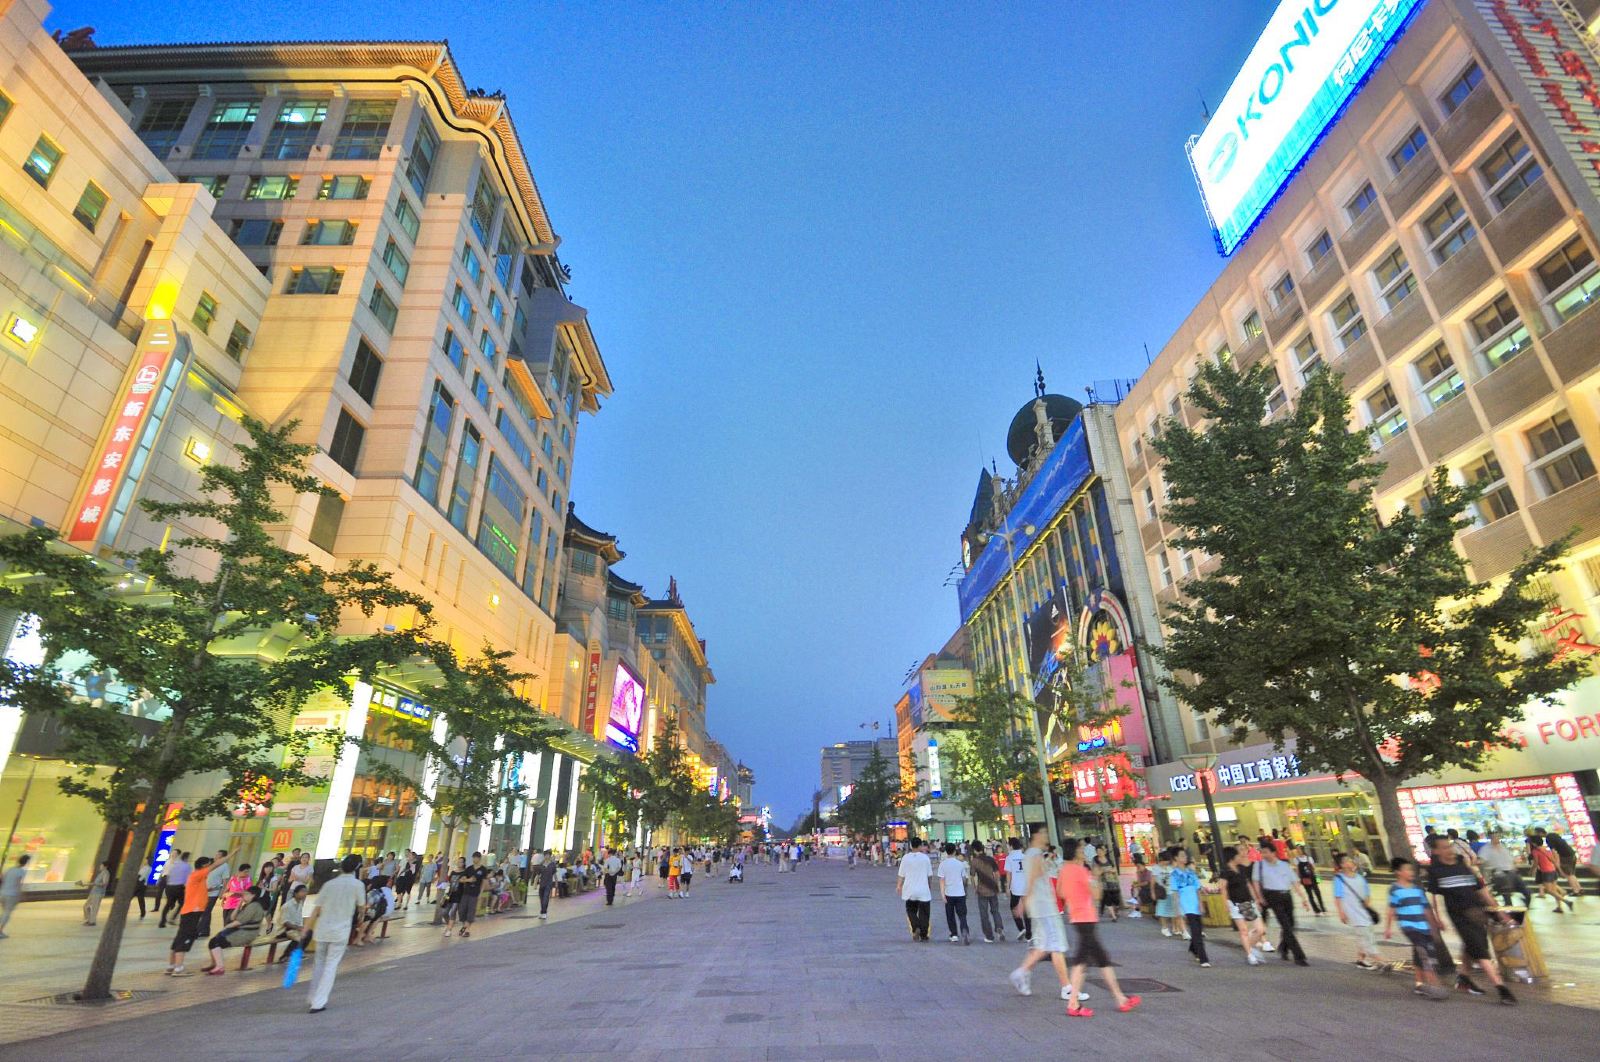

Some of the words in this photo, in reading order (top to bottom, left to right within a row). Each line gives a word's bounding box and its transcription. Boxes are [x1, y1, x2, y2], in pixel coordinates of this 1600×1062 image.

[79, 401, 145, 524] 新东安影城
[1537, 711, 1600, 745] FOR
[1169, 773, 1197, 792] ICBC
[1018, 861, 1024, 871] 1
